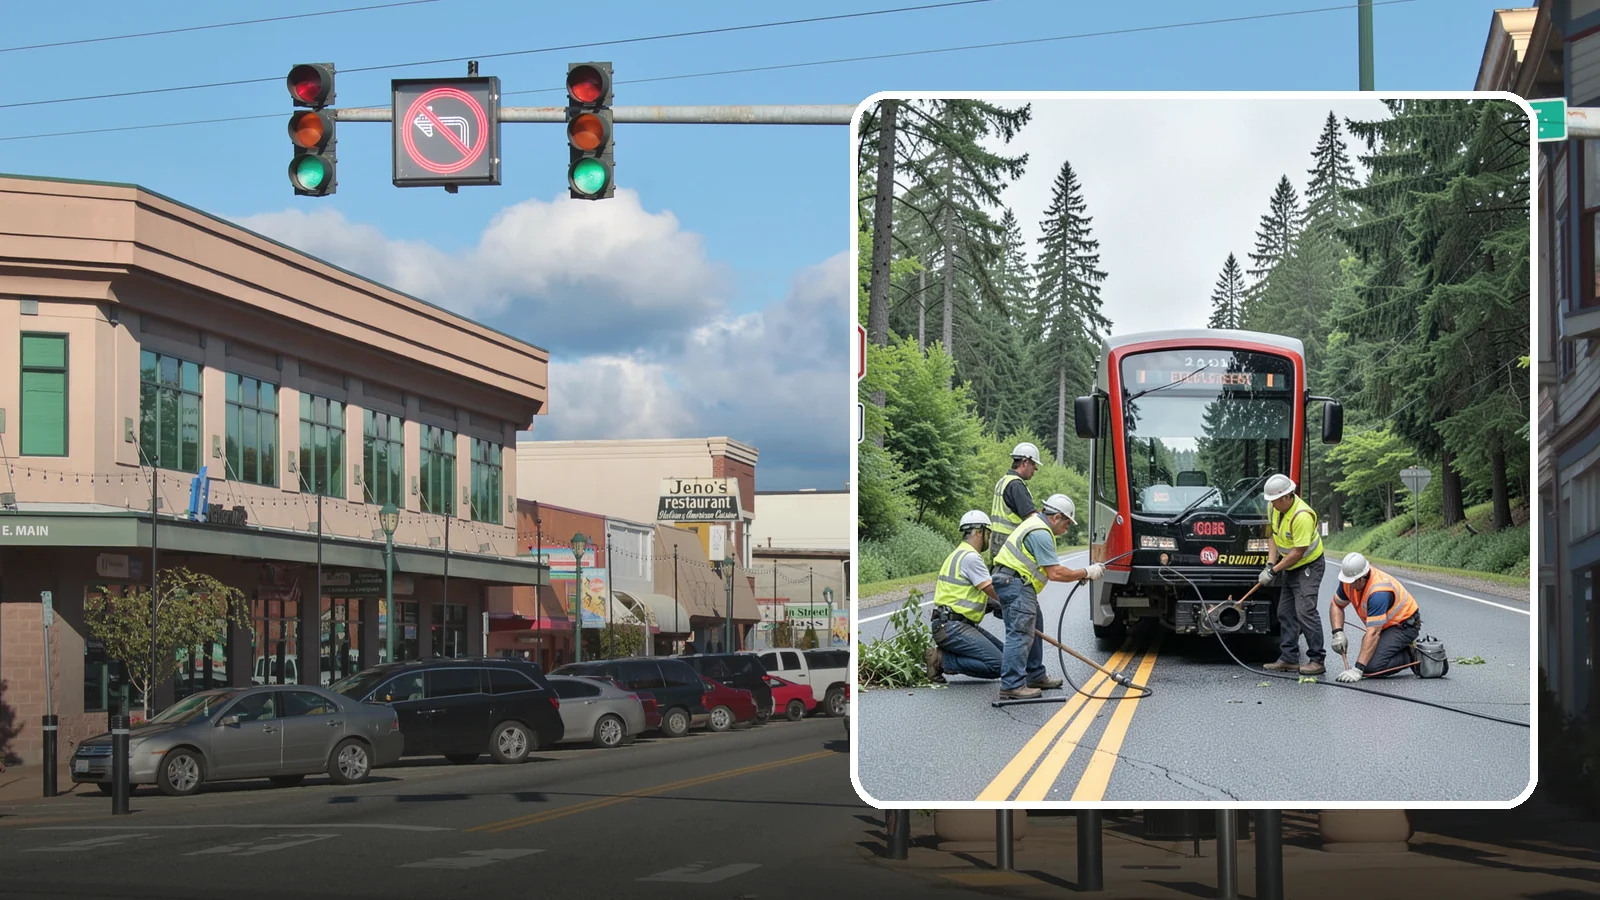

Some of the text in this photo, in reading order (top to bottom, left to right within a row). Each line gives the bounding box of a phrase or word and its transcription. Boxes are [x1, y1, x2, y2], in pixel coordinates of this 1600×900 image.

[670, 480, 727, 494] Jeno's
[665, 496, 731, 509] restaurant
[658, 509, 681, 519] Italian
[686, 510, 714, 519] American
[715, 509, 738, 519] Cuisine
[2, 525, 49, 536] E. MAIN
[785, 607, 828, 617] in Street
